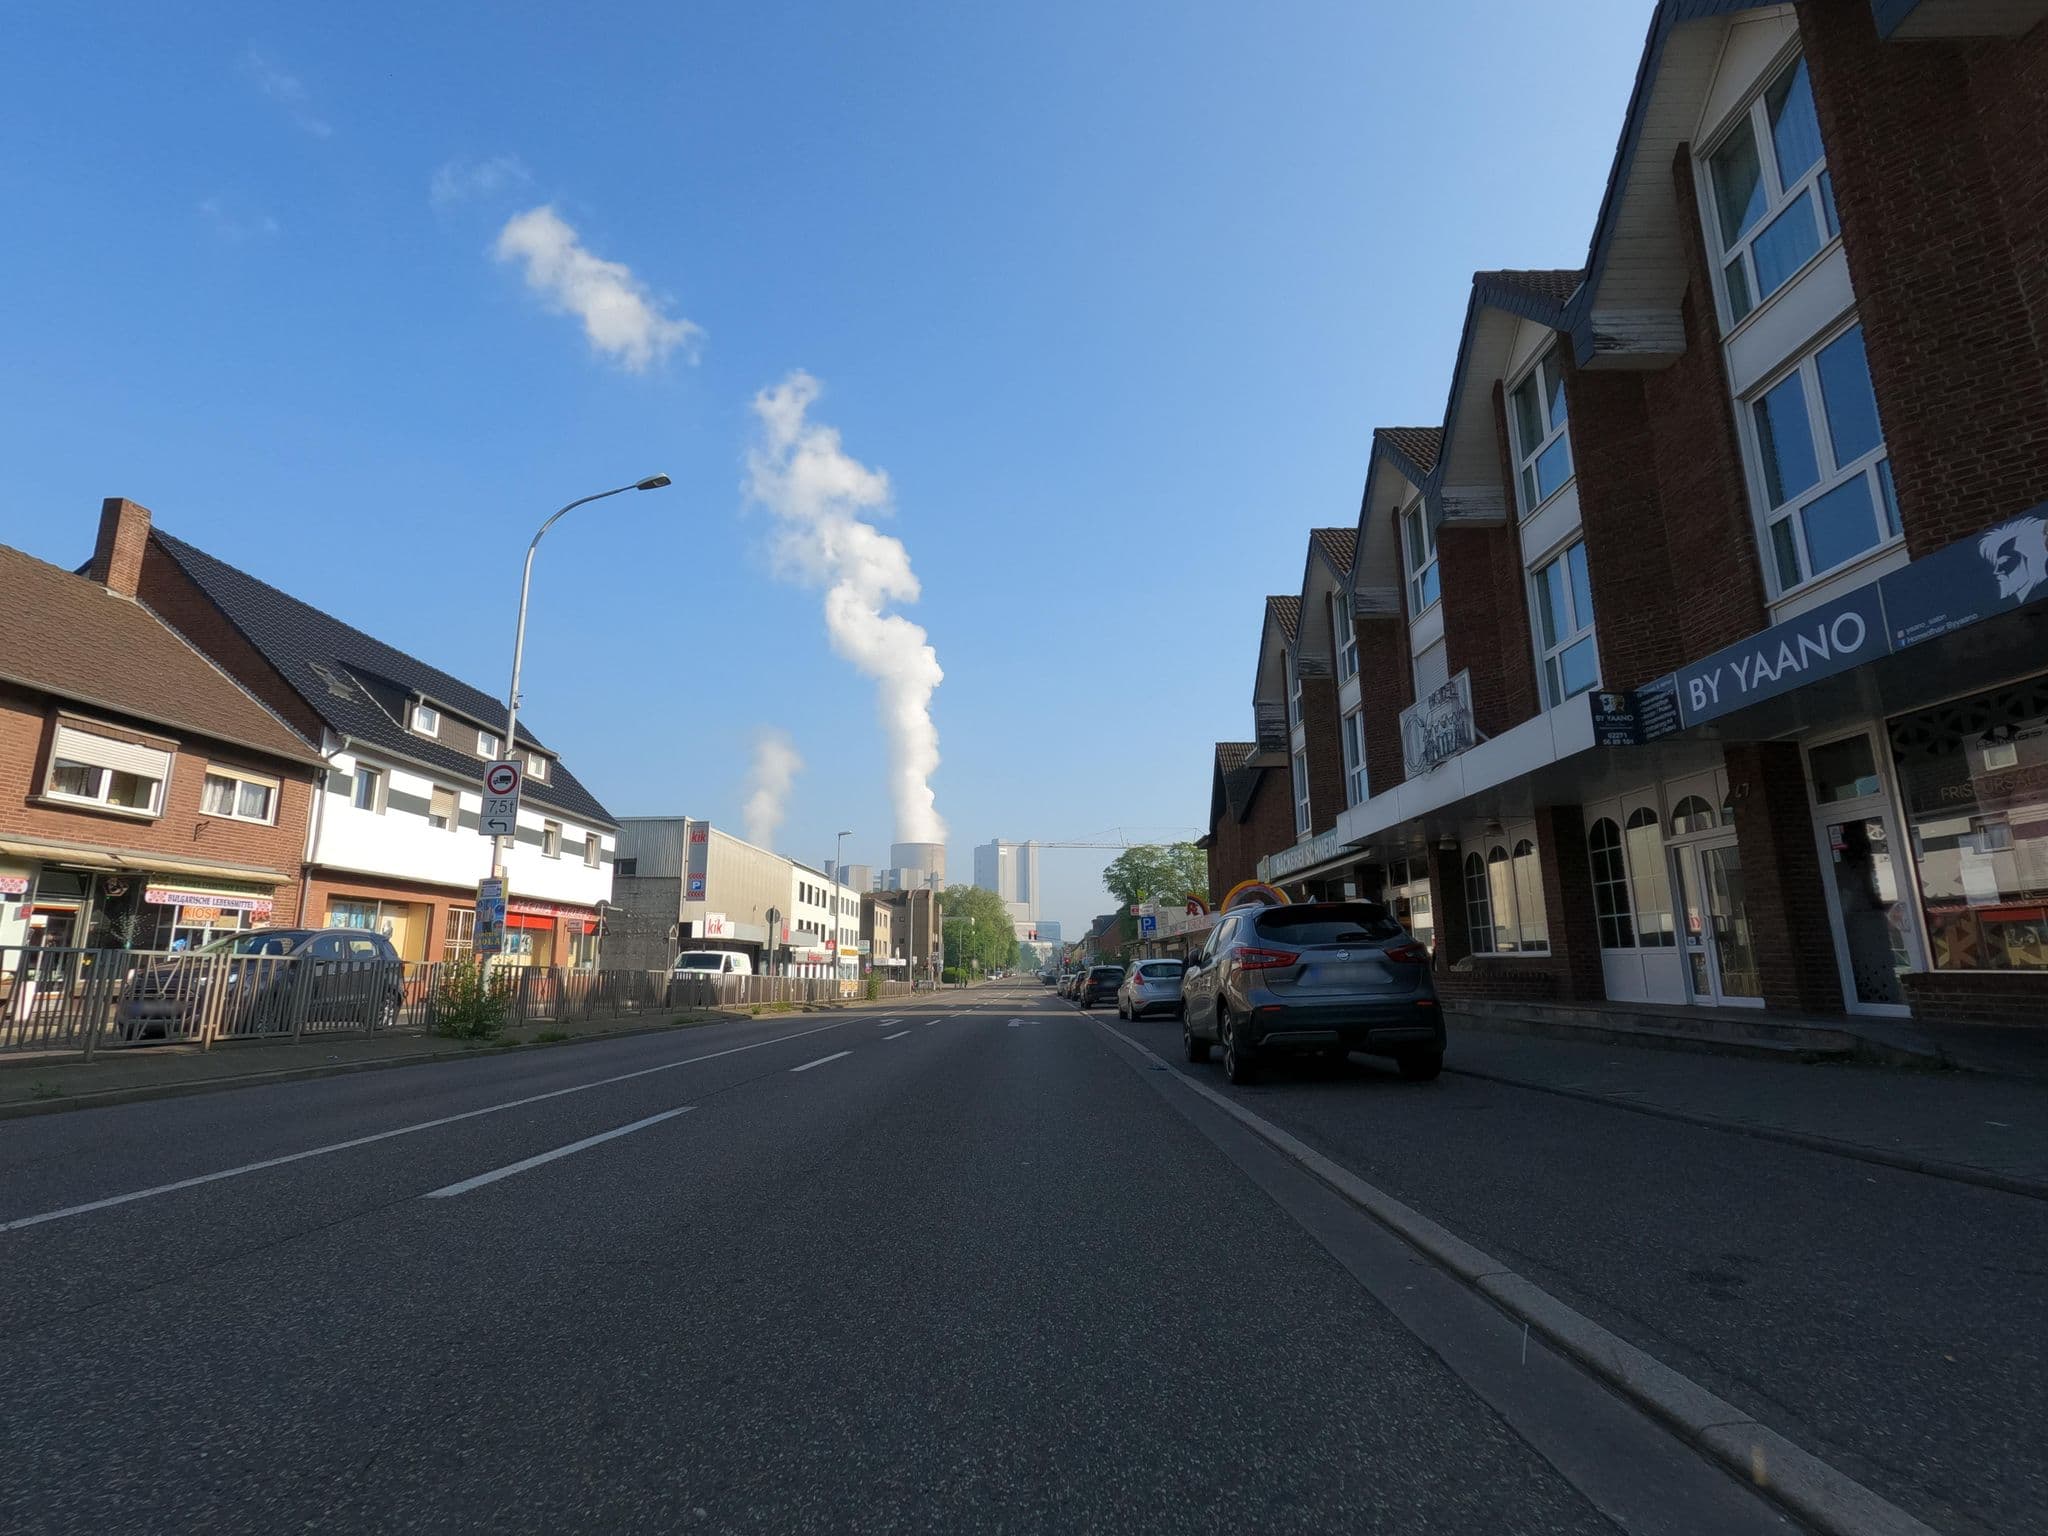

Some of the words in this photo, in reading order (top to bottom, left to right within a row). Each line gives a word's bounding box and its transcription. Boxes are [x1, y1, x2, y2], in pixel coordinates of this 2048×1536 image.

[1688, 667, 1722, 712] BY
[1729, 612, 1866, 693] YAANO
[1606, 714, 1634, 722] YAANO
[691, 831, 707, 843] kik
[168, 894, 211, 906] BULGARISCHE
[212, 898, 254, 909] LEBENSMITTEL
[183, 907, 220, 920] KIOSK
[707, 918, 724, 937] kik
